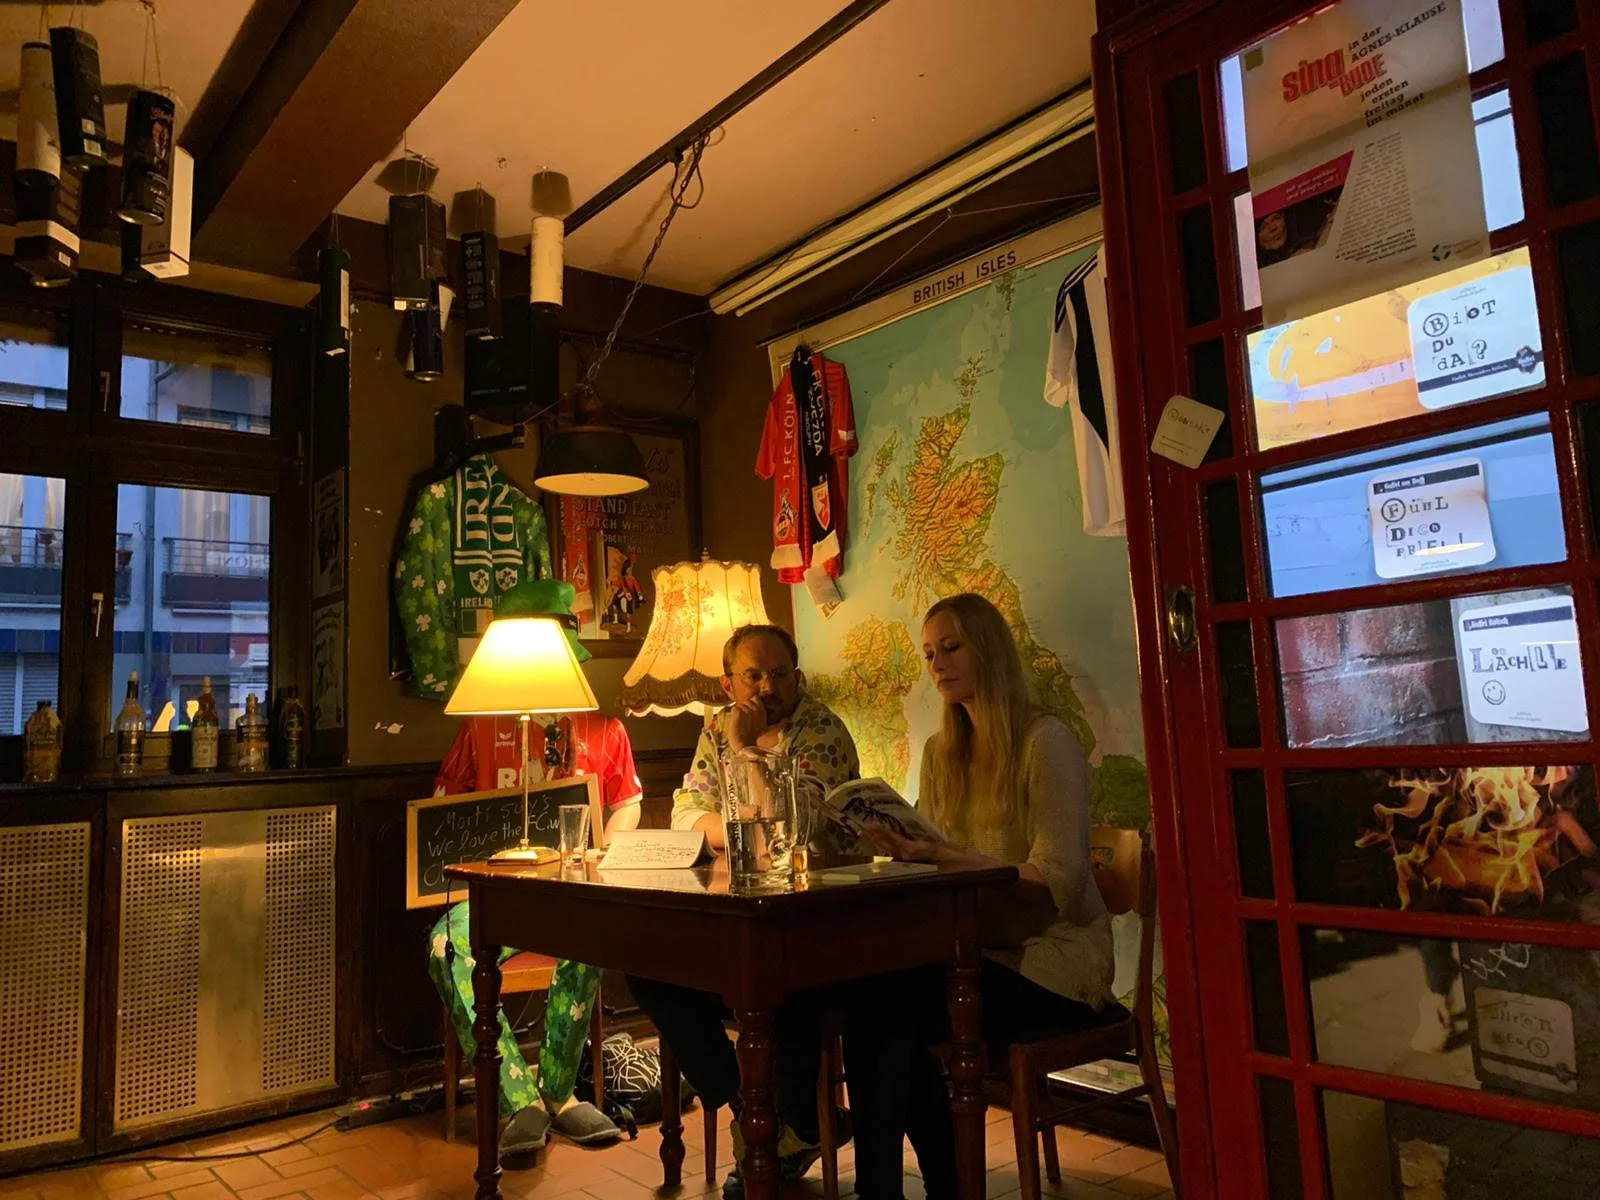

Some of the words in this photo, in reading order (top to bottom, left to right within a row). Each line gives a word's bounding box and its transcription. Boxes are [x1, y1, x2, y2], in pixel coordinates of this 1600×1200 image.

[1348, 36, 1362, 51] in
[1365, 26, 1382, 43] der
[1351, 2, 1446, 63] AGNES-KLAUSE
[1282, 47, 1347, 102] sing
[1360, 78, 1393, 103] jeden
[1371, 79, 1408, 105] ersten
[1364, 93, 1404, 119] freitag
[1366, 113, 1384, 128] im
[1386, 92, 1425, 117] monat
[913, 271, 965, 304] BRITISH
[975, 250, 1017, 280] ISLES
[783, 393, 795, 439] KÖLN
[783, 445, 793, 464] FC
[576, 497, 628, 515] STAND
[457, 829, 498, 852] love
[502, 822, 522, 840] the
